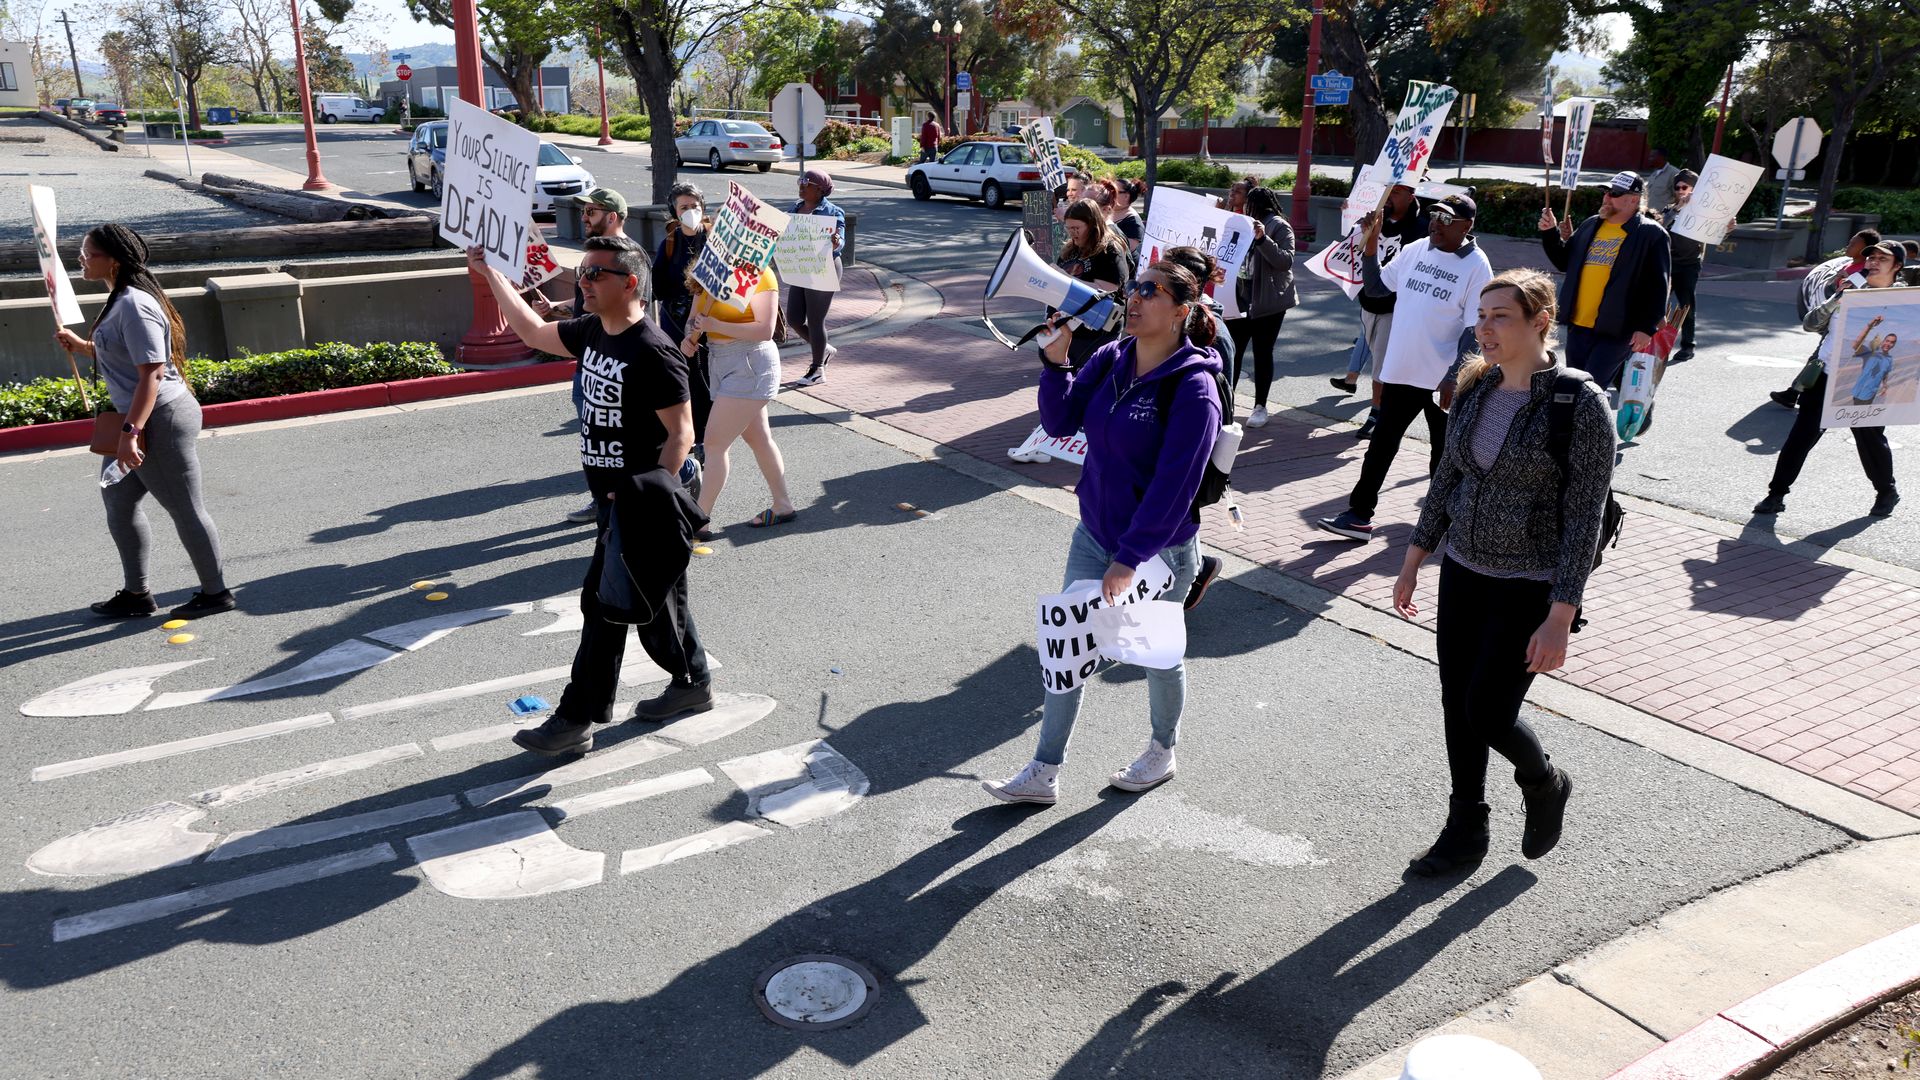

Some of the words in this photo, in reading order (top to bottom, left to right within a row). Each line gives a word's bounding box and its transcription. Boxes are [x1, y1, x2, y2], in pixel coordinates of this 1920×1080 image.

[1326, 80, 1341, 88] Third
[1325, 95, 1342, 103] Street
[476, 174, 493, 200] IS
[730, 181, 761, 216] BLACK
[445, 183, 525, 268] DEADLY
[720, 208, 735, 229] ALL
[734, 223, 771, 250] LIVES
[726, 195, 746, 223] LIVES
[744, 216, 780, 242] MATTER
[702, 242, 734, 283] TERRY
[1415, 261, 1460, 285] Rodriguez
[692, 262, 733, 301] AMONS
[1028, 276, 1049, 290] PYLE
[1406, 278, 1433, 294] MUST
[1432, 286, 1452, 302] GO!
[582, 371, 620, 405] IVES
[1835, 406, 1887, 426] Angelo
[580, 437, 624, 456] BLIC
